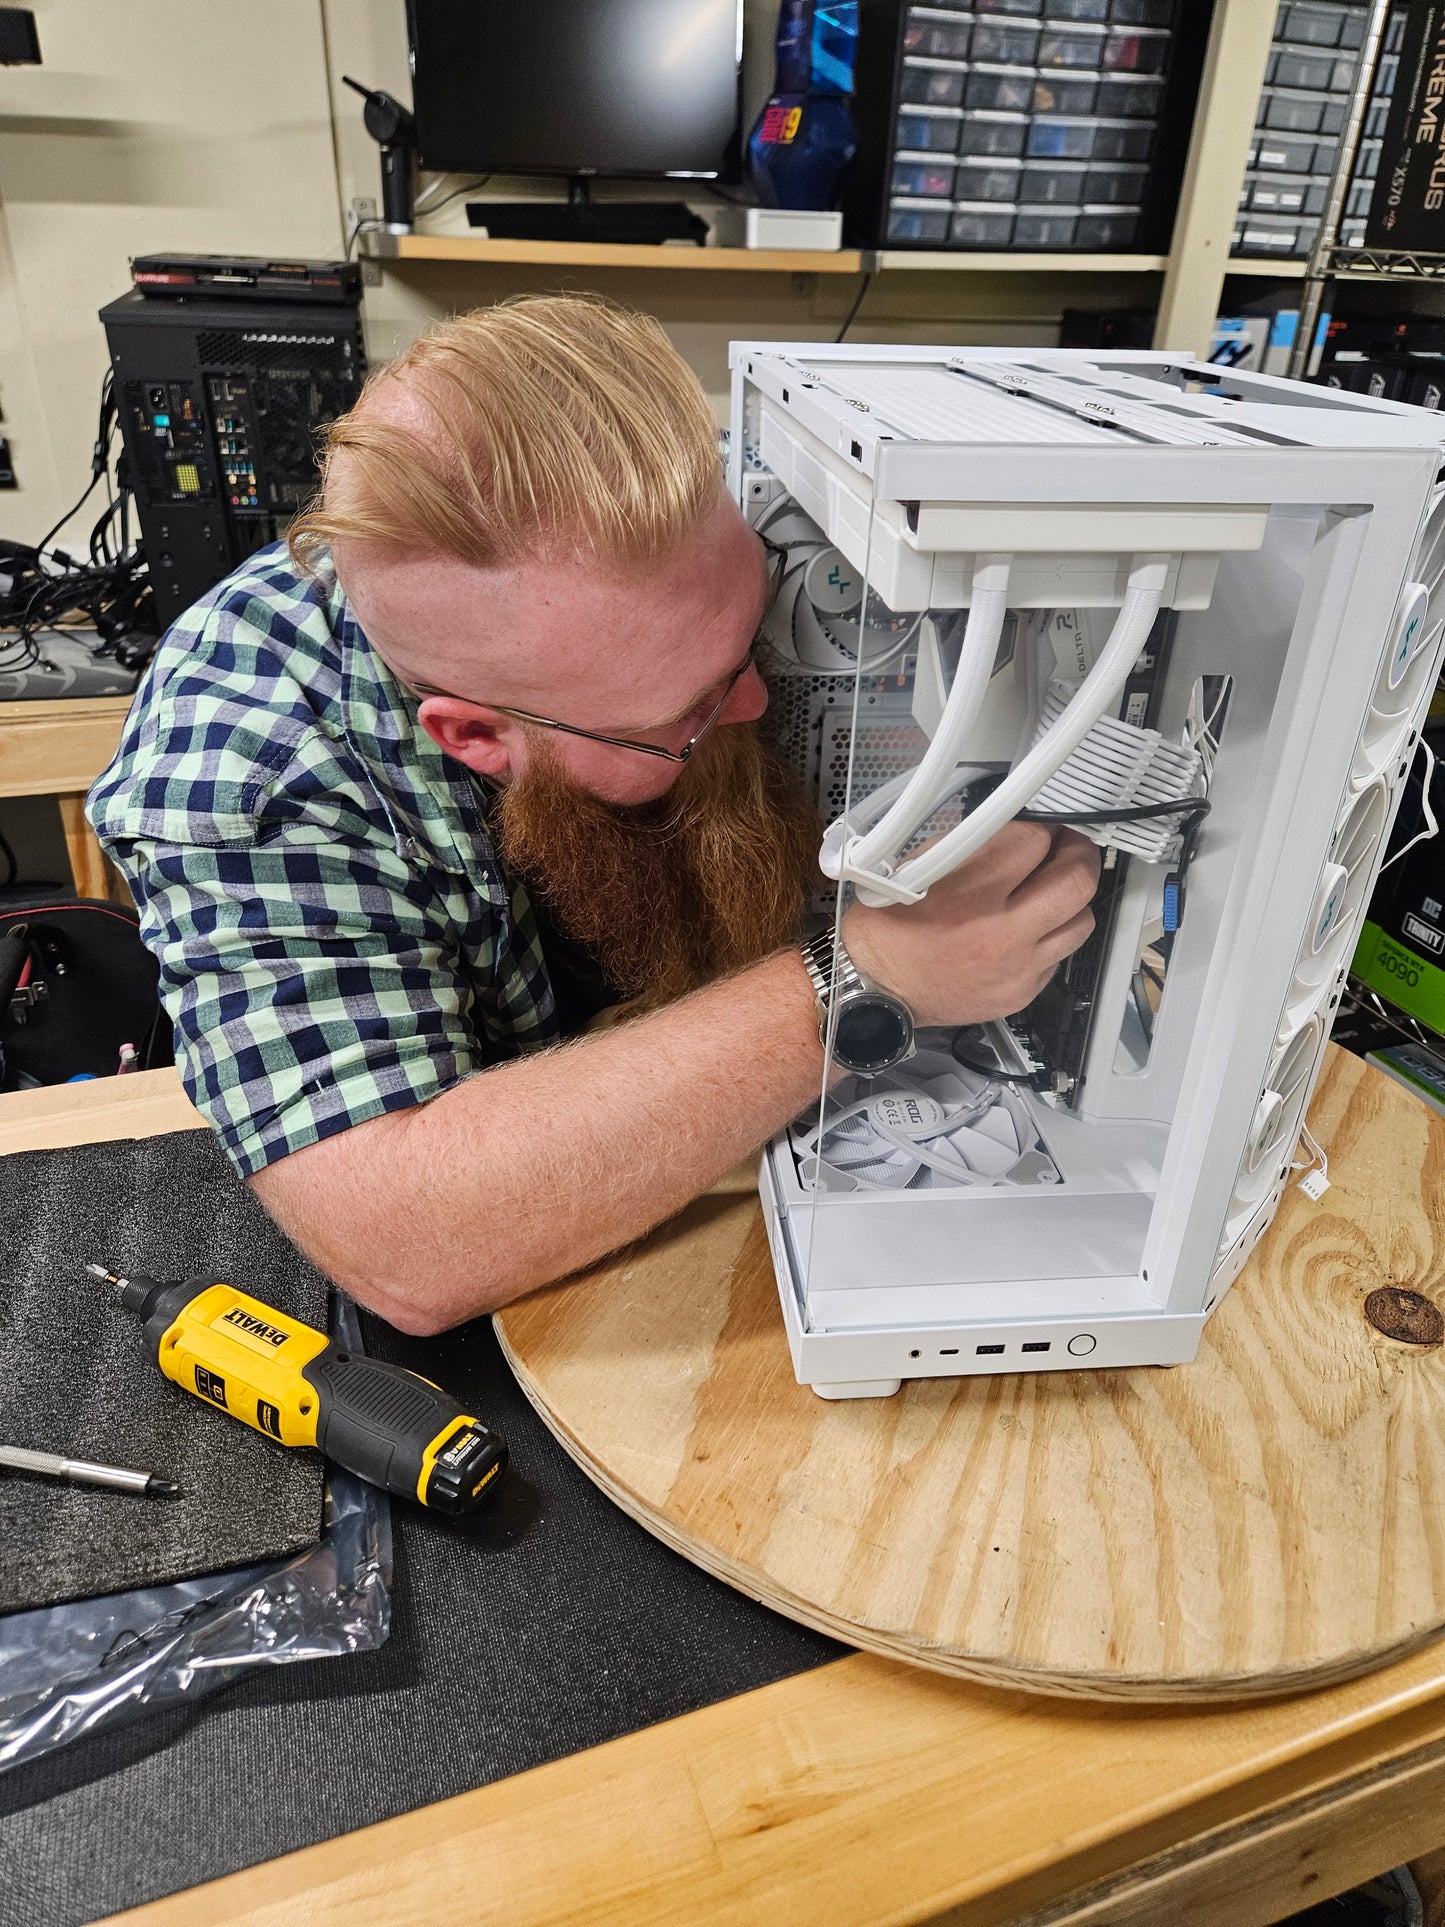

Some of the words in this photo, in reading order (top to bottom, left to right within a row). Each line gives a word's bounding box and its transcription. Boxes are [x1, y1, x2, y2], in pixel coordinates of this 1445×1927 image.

[1387, 166, 1409, 207] X570
[1074, 631, 1087, 673] DELTA
[1377, 951, 1420, 988] 4090
[904, 1099, 924, 1124] ROG
